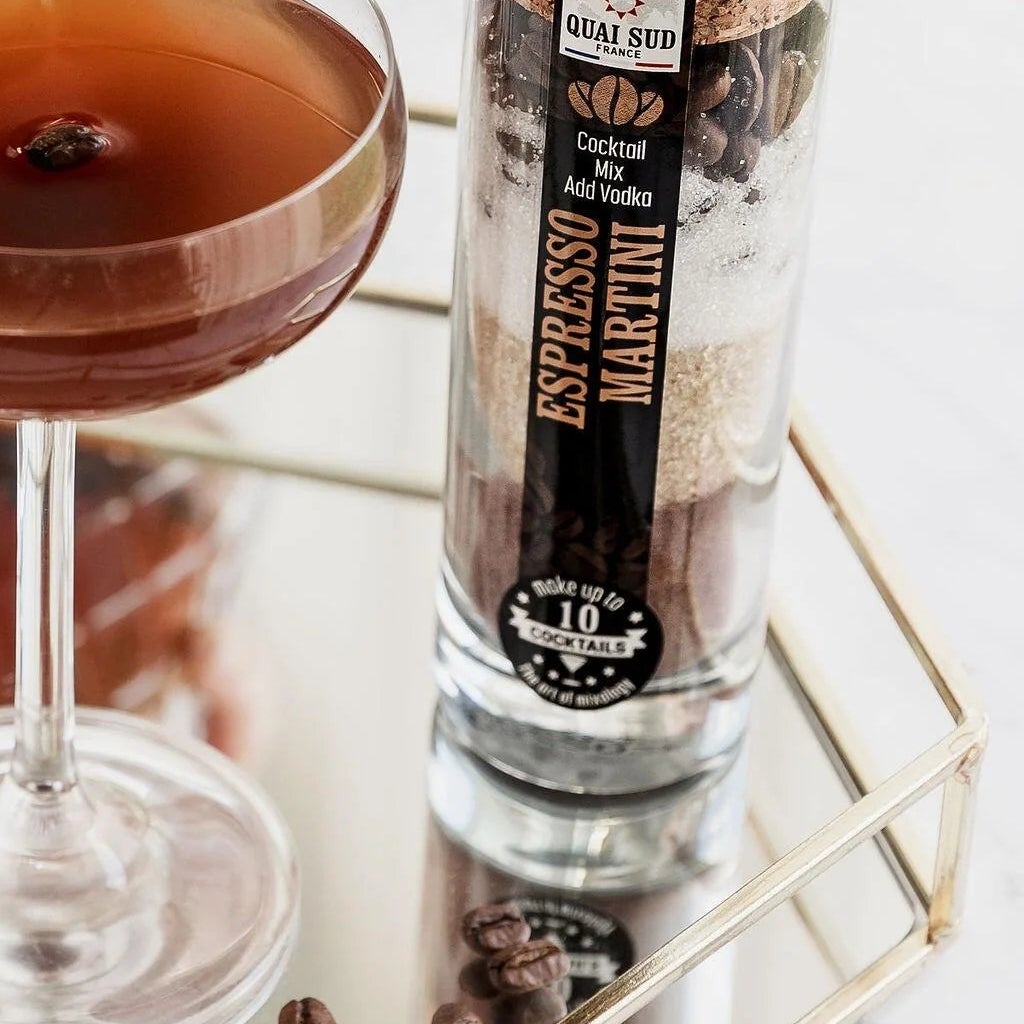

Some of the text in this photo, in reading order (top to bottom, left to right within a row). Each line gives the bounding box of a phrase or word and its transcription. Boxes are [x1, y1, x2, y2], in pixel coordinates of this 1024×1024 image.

[566, 13, 676, 50] QUAI SUD
[596, 43, 641, 59] FRANCE
[577, 131, 647, 160] Cocktail
[594, 158, 624, 182] Mix
[563, 175, 653, 208] Add Vodka
[536, 208, 600, 429] ESPRESSO
[599, 221, 666, 406] MARTINI
[580, 583, 604, 604] up
[602, 591, 626, 612] to
[559, 600, 600, 634] 10
[531, 626, 626, 653] COCKTAILS
